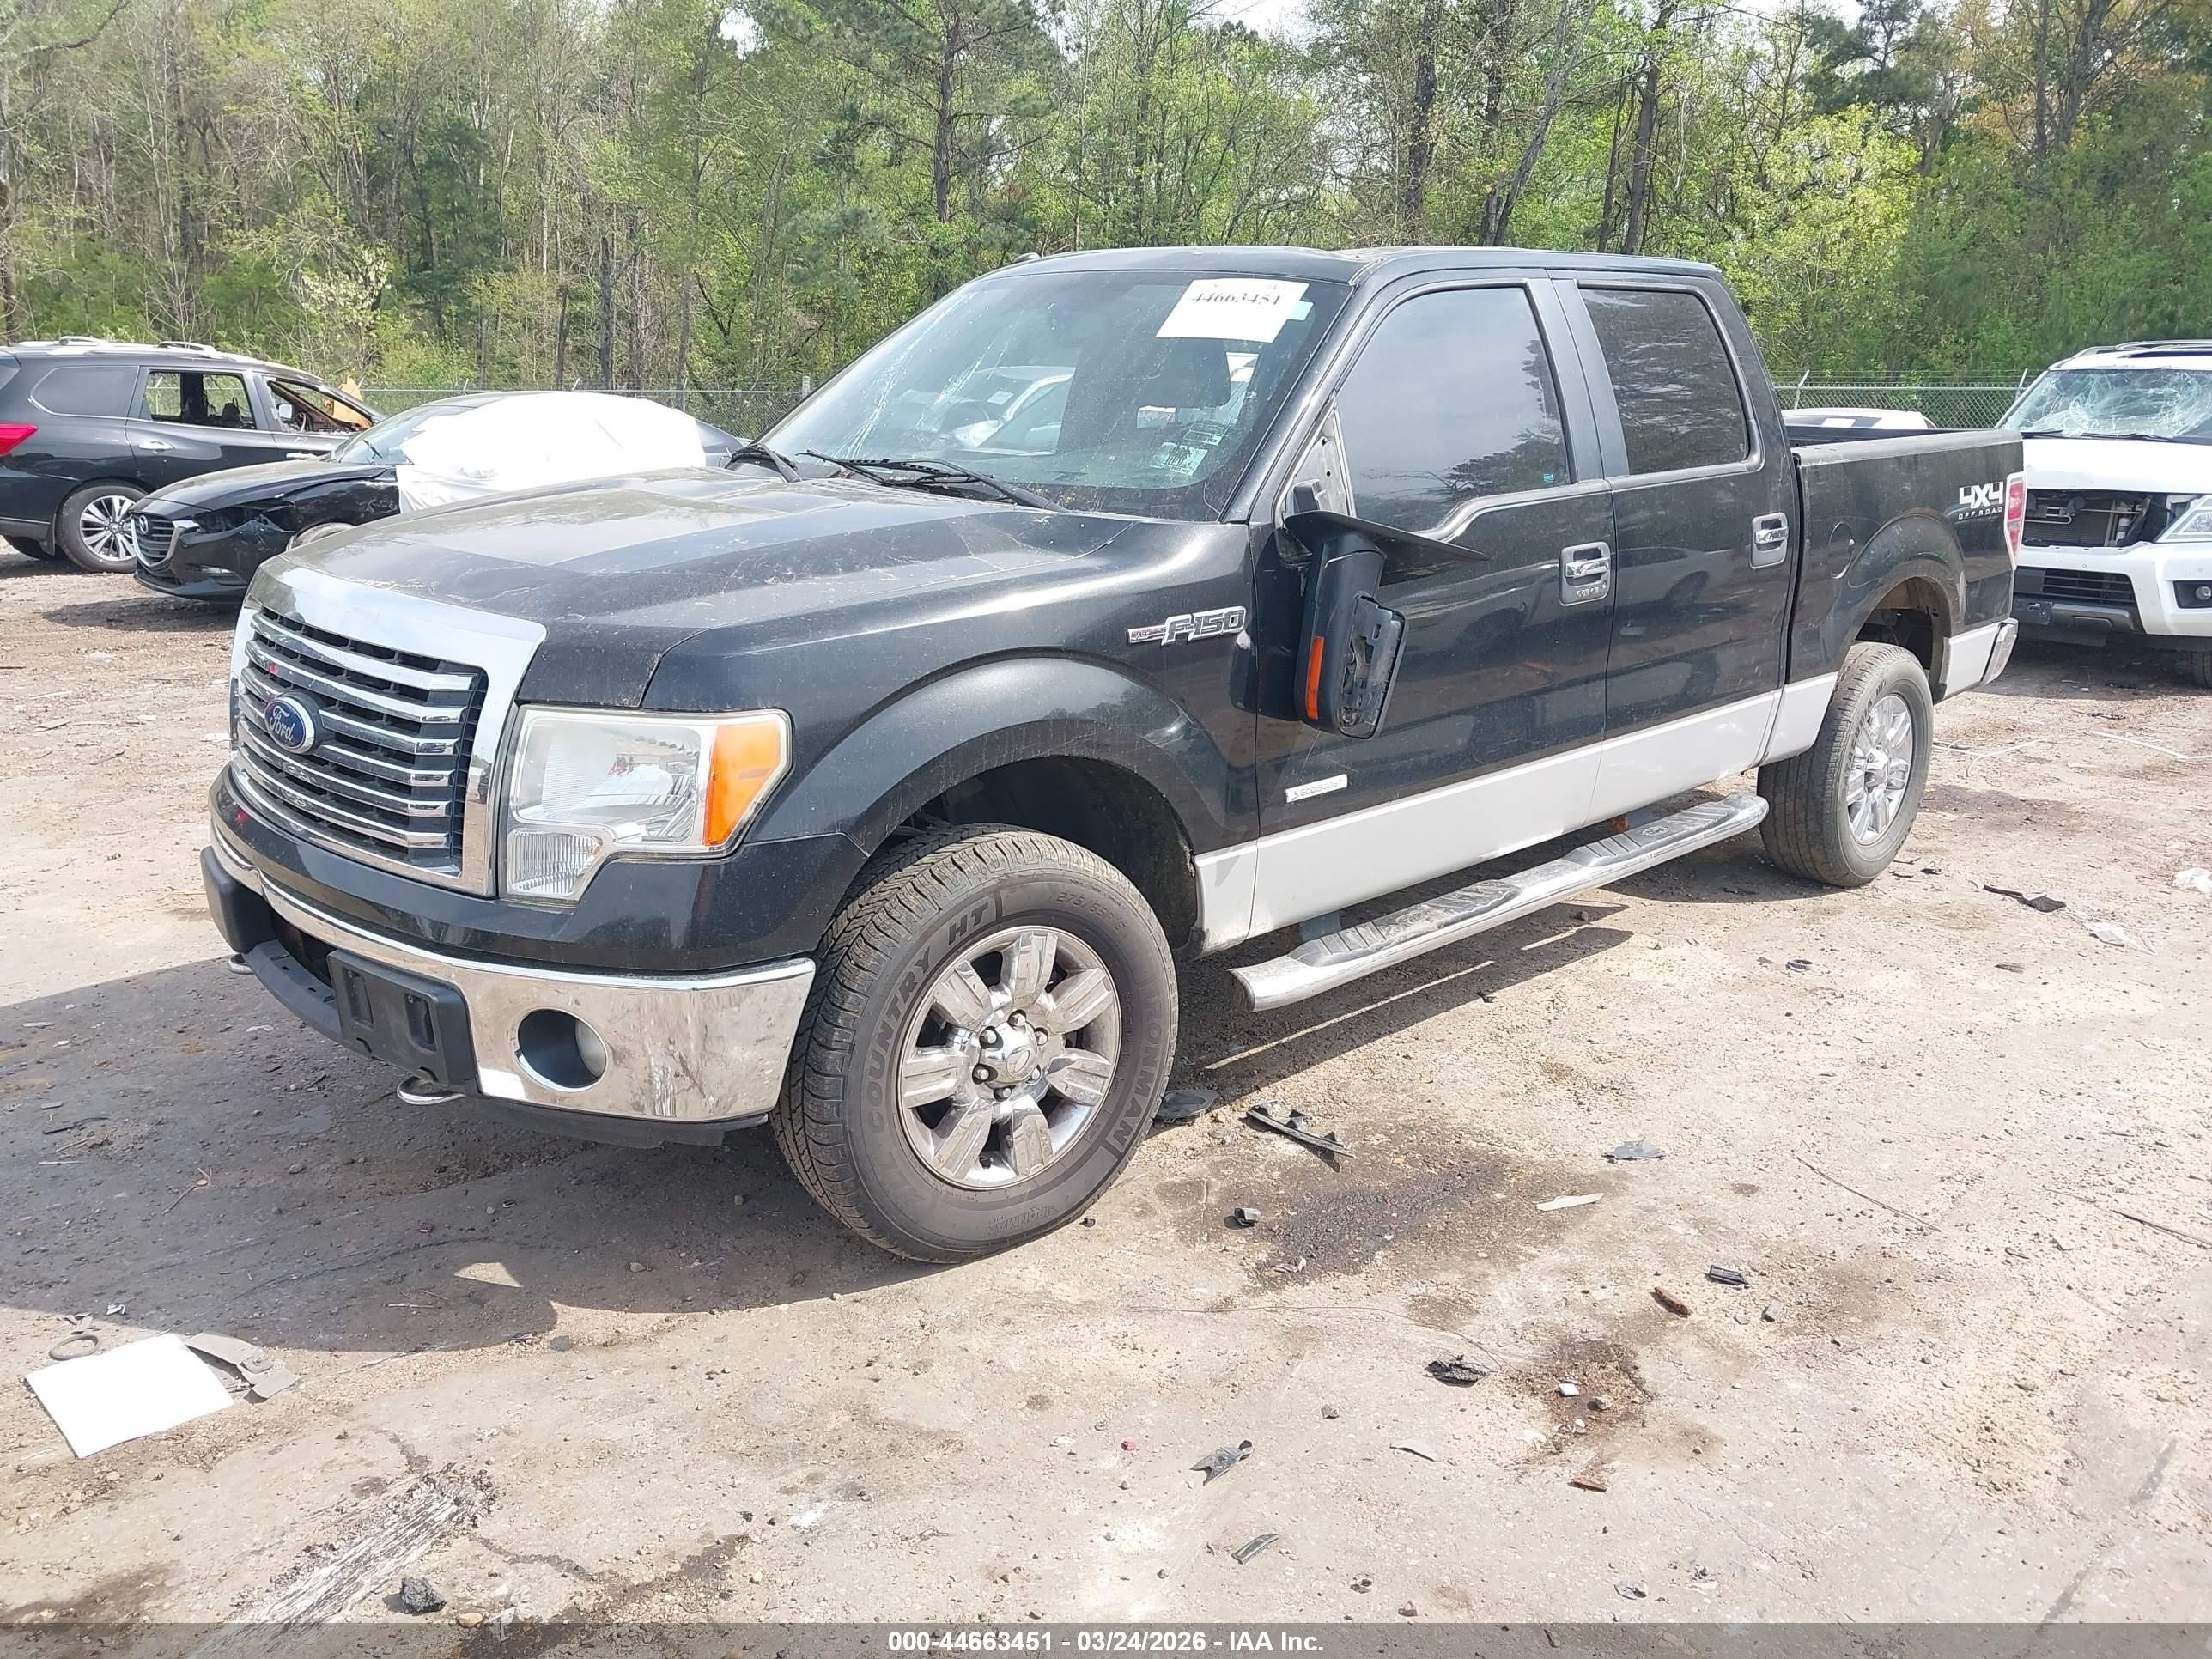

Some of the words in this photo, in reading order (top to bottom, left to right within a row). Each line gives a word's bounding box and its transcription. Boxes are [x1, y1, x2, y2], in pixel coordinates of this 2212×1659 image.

[1189, 292, 1282, 306] 44663451
[1959, 481, 2004, 509] 4X4
[1958, 511, 1976, 520] OFF
[1978, 506, 2002, 516] ROAD
[1161, 605, 1247, 646] F-150
[269, 705, 296, 742] Ford
[866, 946, 931, 1134] COUNTRY
[948, 906, 988, 945] HT
